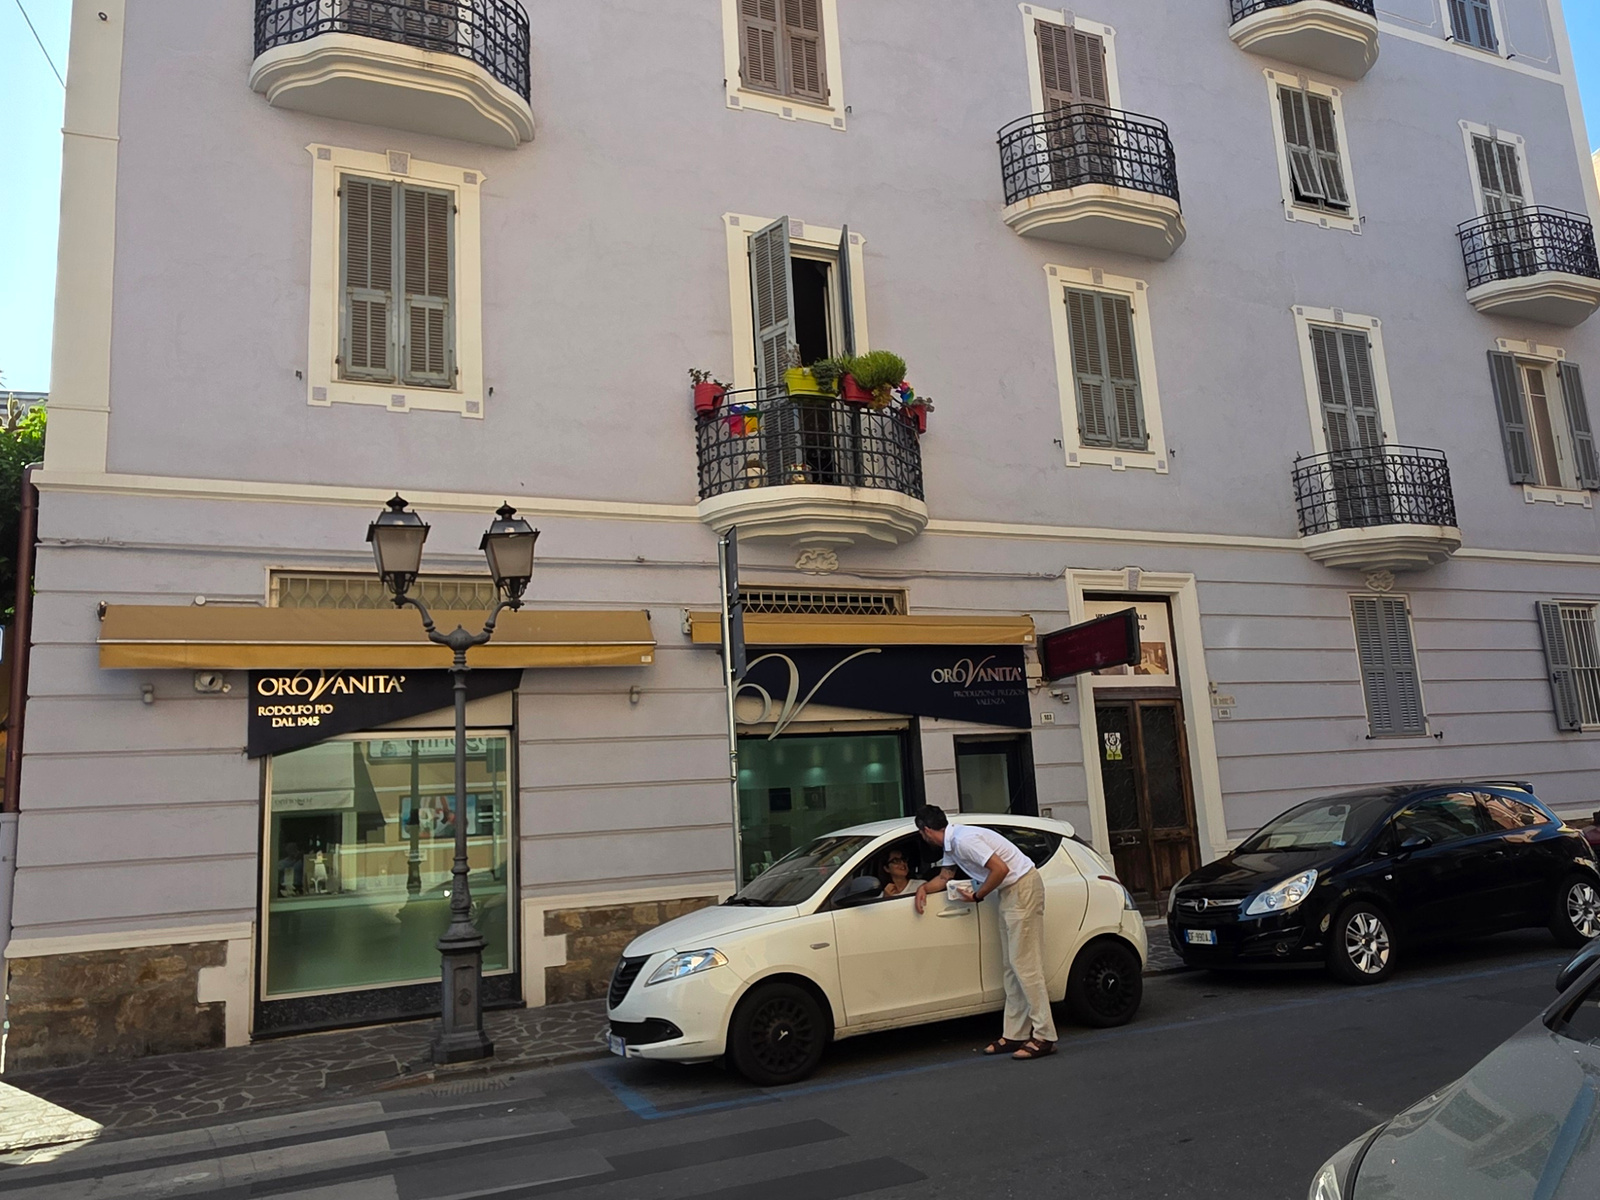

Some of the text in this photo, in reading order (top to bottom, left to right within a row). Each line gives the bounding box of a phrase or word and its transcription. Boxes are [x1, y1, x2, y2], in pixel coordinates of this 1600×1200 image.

[975, 698, 1006, 706] VALENZA
[258, 704, 334, 716] RODOLFO PIO
[272, 716, 320, 728] DAL 1945
